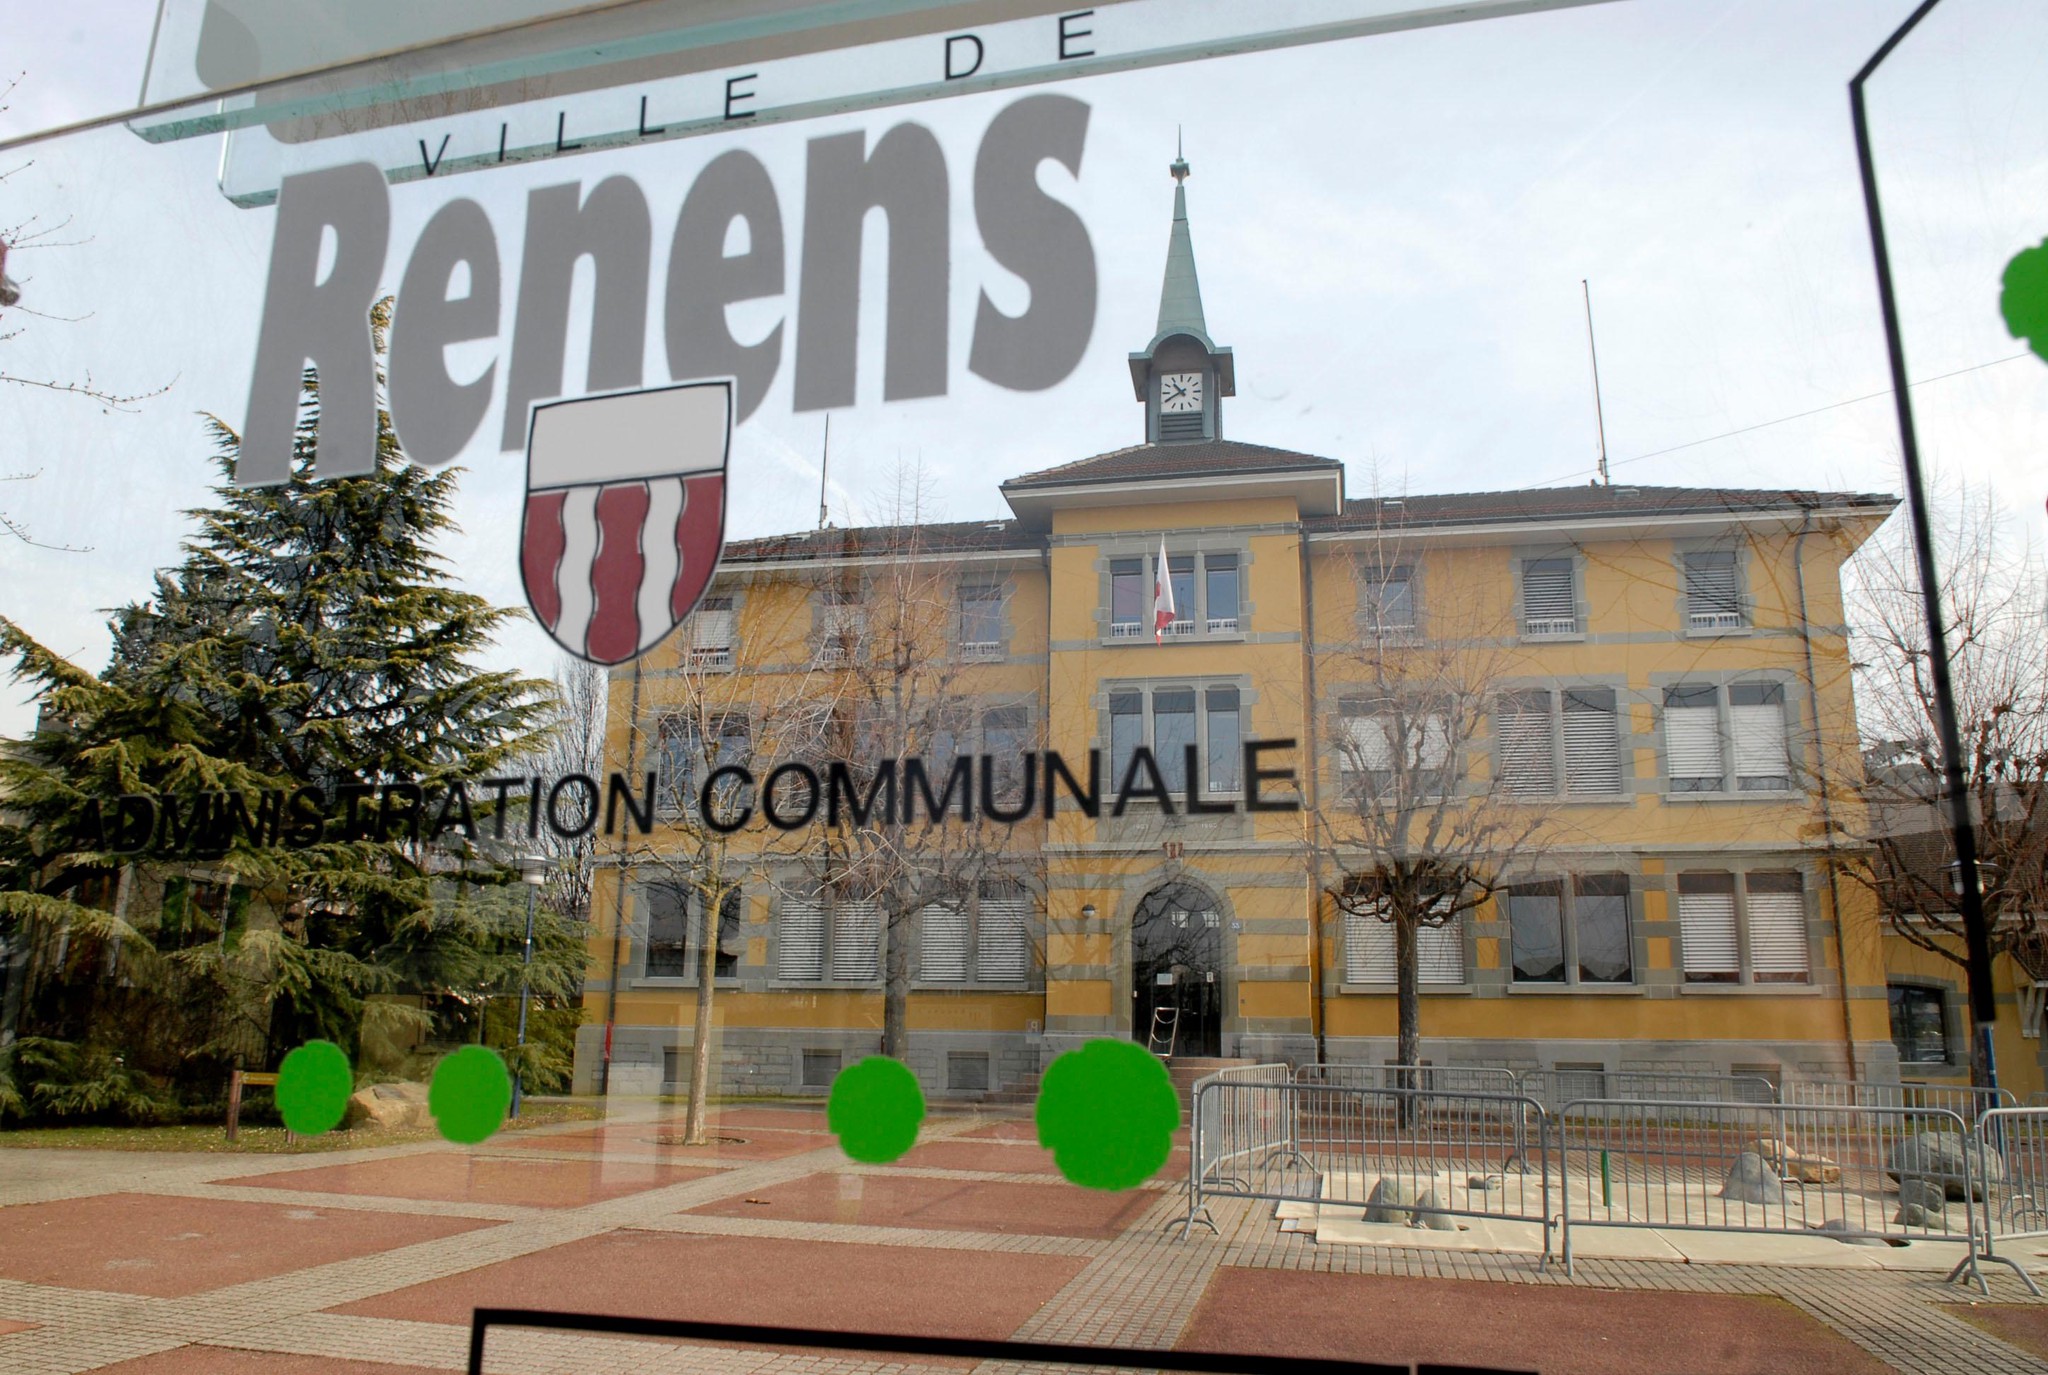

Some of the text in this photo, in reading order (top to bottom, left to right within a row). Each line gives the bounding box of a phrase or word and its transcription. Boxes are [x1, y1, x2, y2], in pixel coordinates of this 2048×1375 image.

[418, 10, 1097, 177] VILLE DE
[234, 93, 1099, 488] Renens
[72, 737, 1299, 858] ADMINISTRATION COMMUNALE
